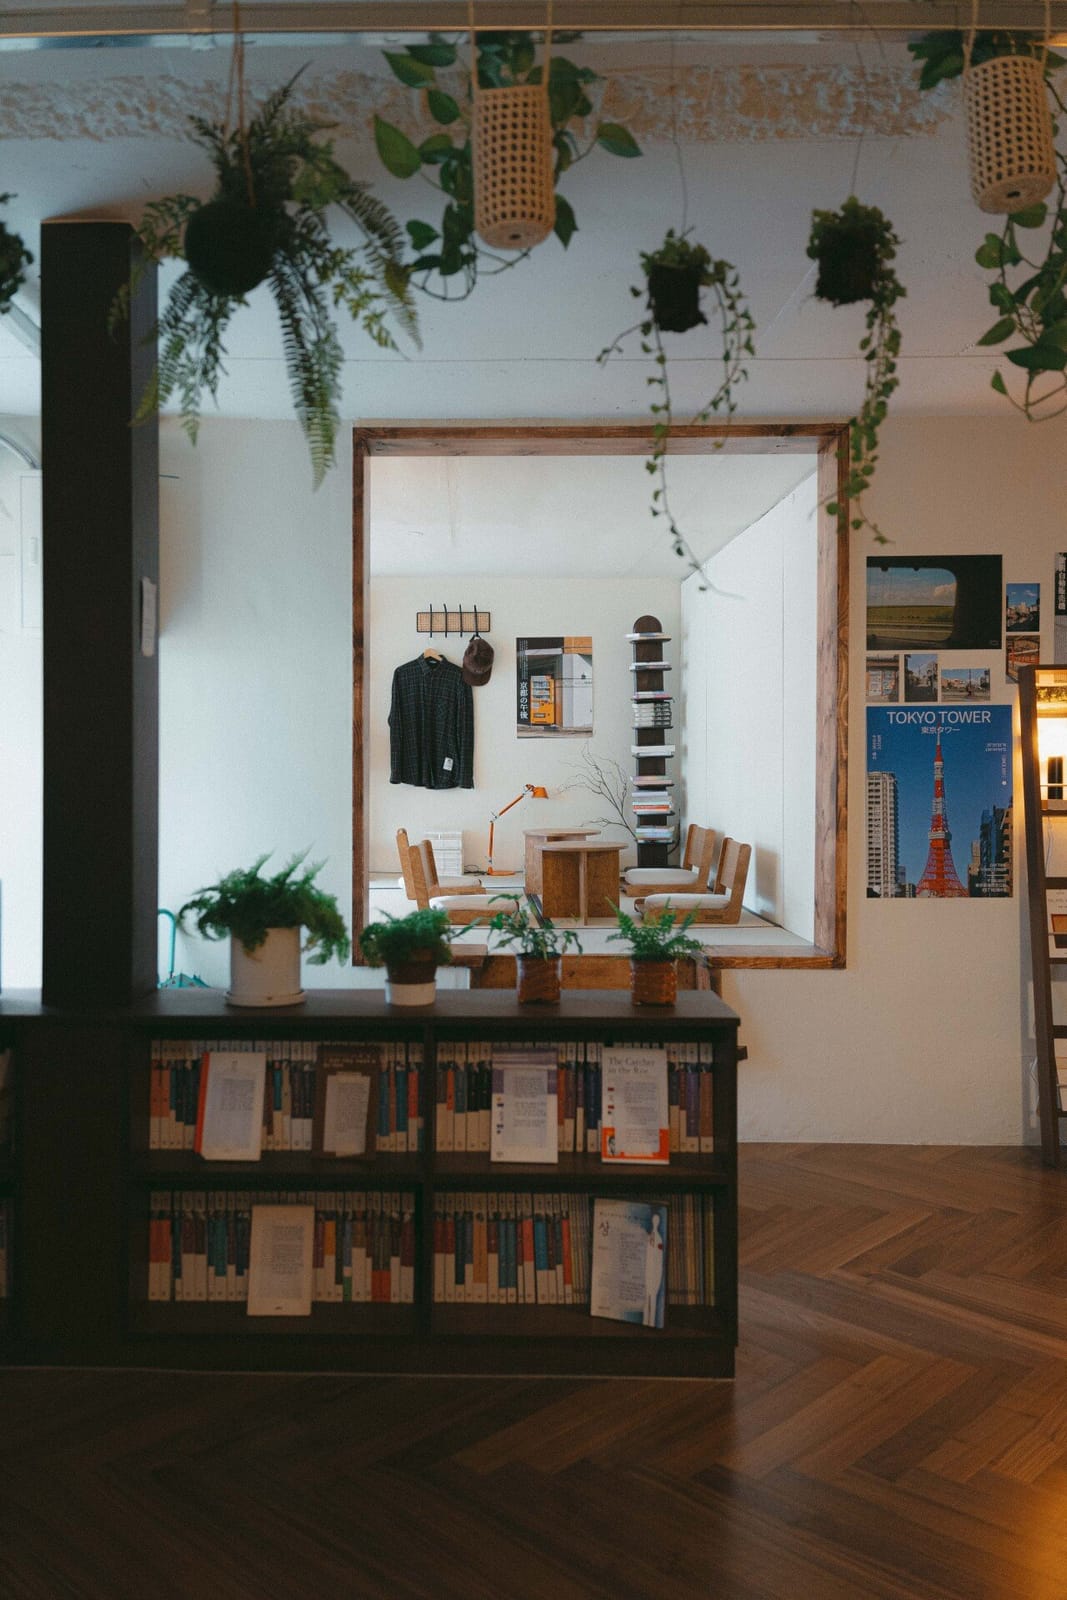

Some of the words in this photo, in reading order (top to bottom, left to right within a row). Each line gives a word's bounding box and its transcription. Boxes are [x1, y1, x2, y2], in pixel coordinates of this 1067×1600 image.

[887, 711, 936, 723] TOKYO
[938, 711, 991, 723] TOWER
[921, 726, 960, 734] 東京タワー
